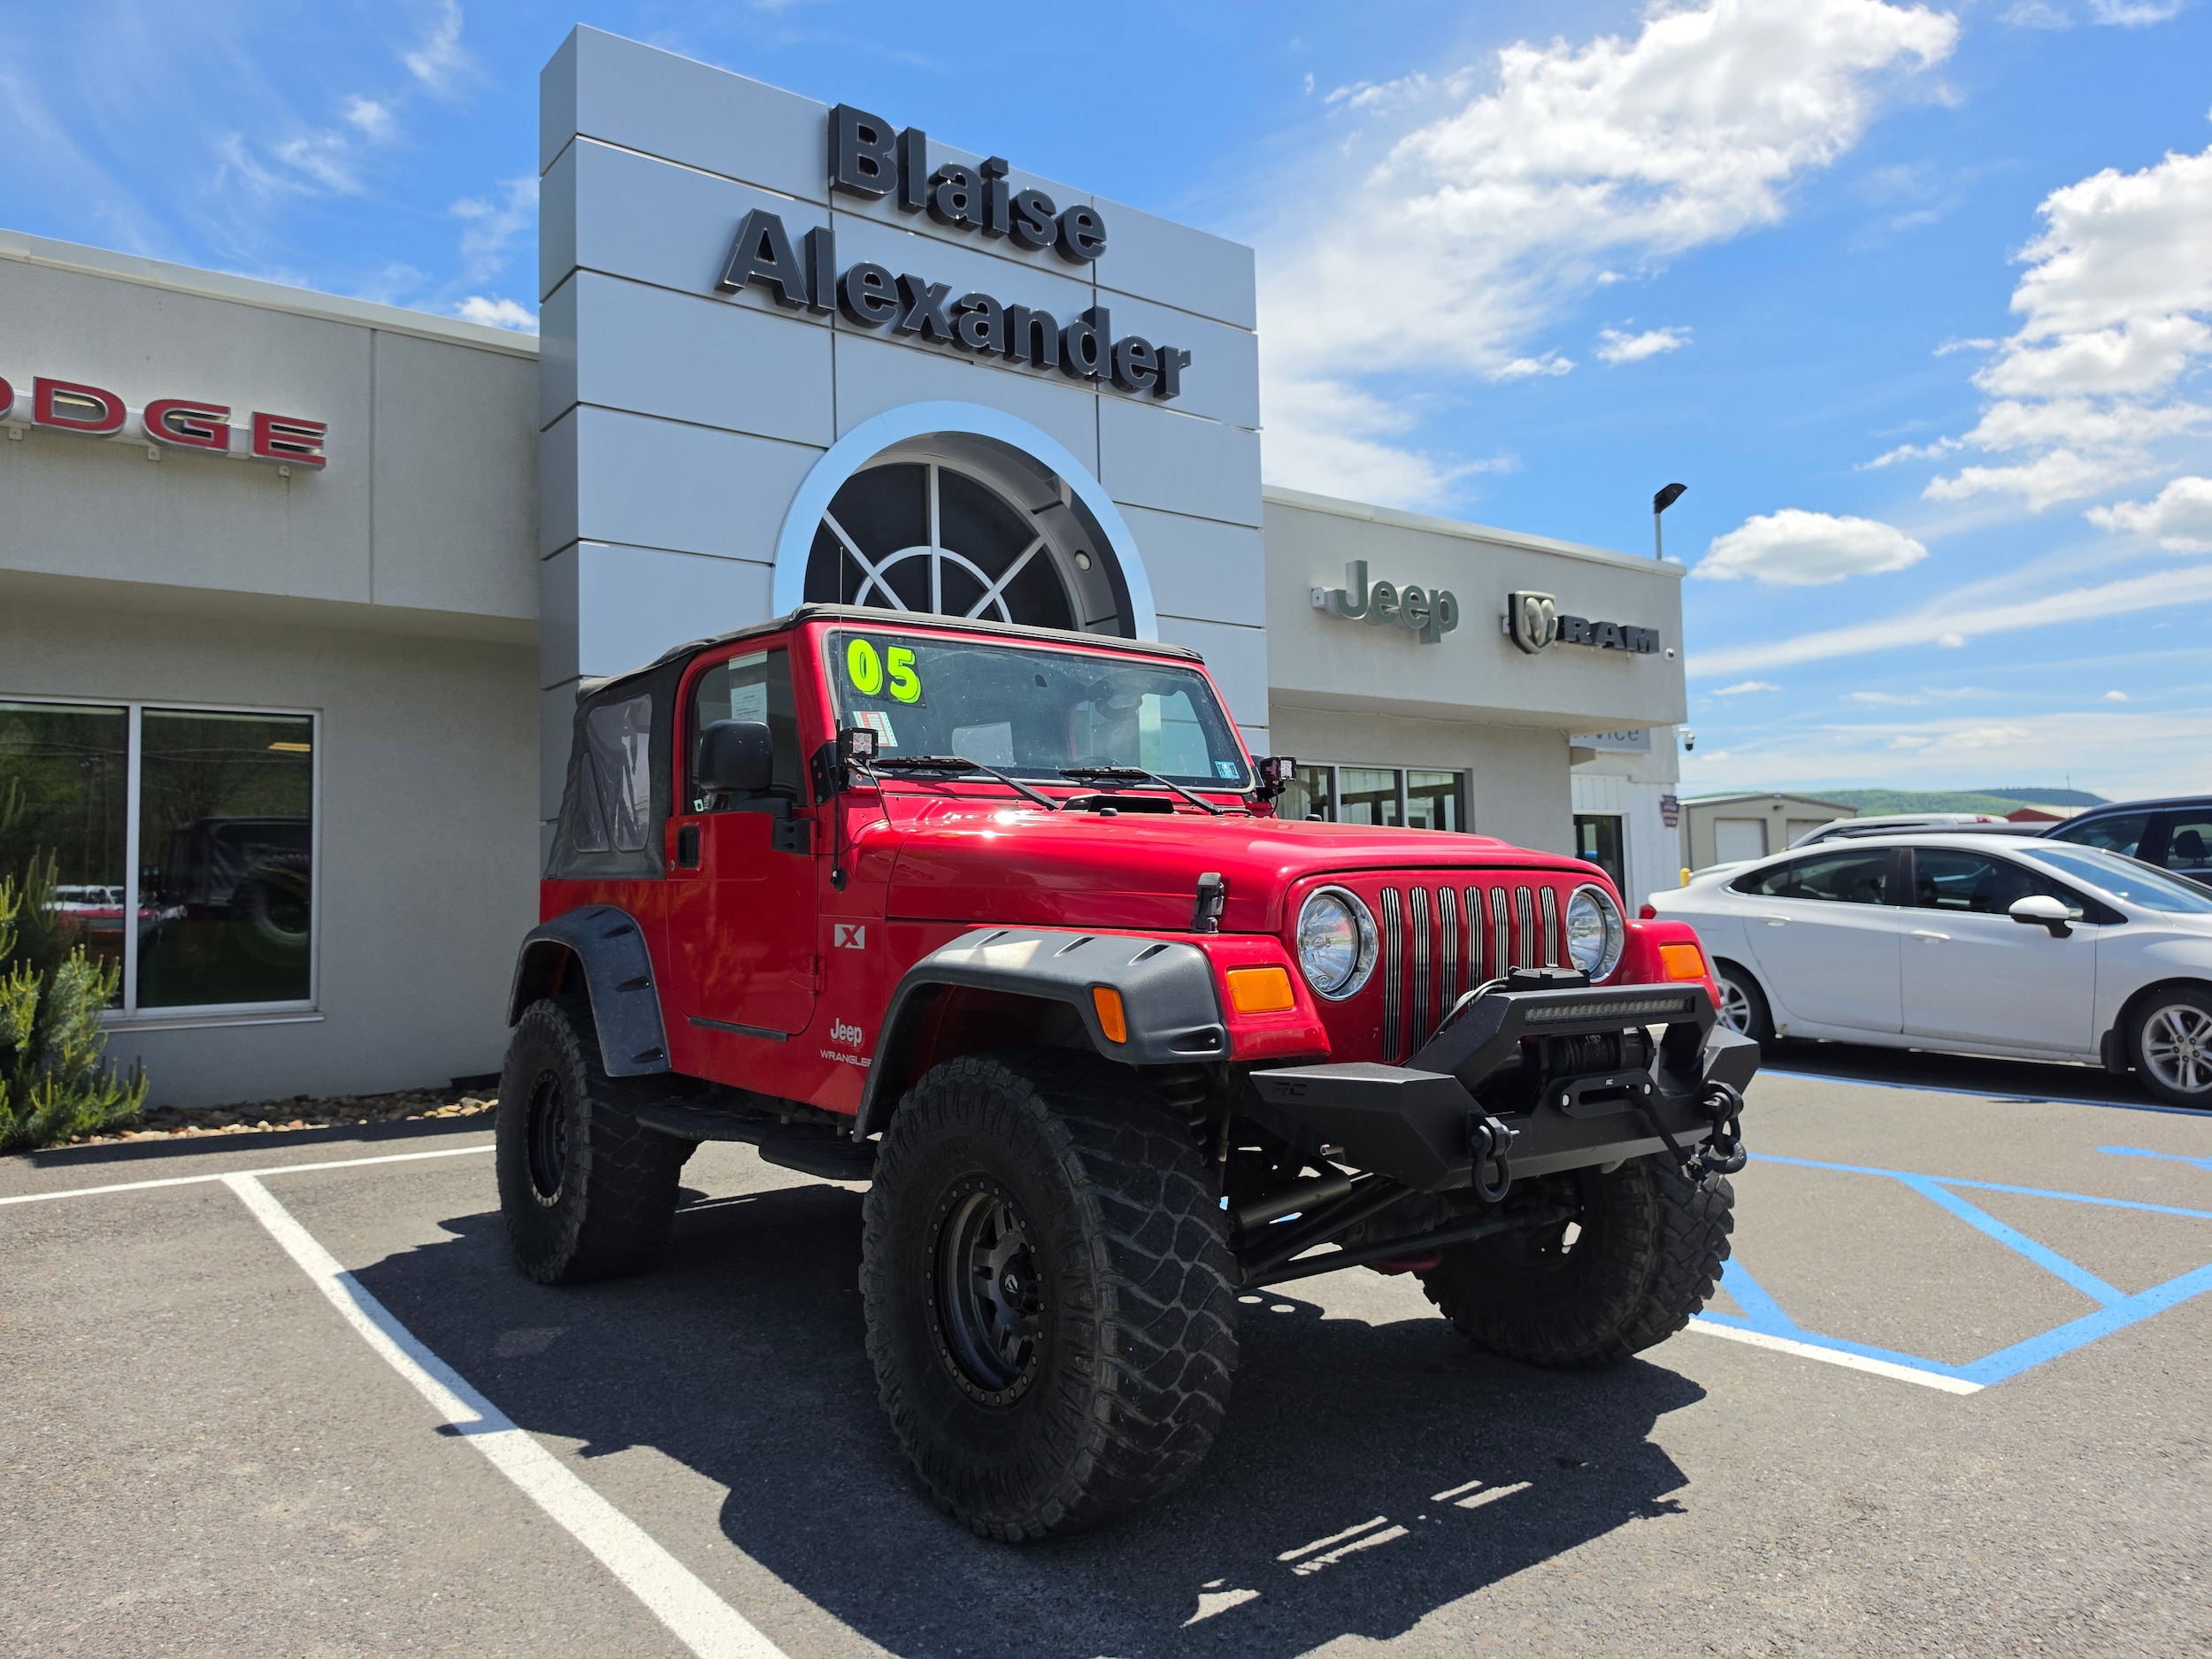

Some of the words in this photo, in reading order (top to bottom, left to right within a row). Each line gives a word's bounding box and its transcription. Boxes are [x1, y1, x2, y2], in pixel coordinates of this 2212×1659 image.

[829, 103, 1108, 265] Blaise
[715, 208, 1191, 400] Alexander
[0, 375, 327, 470] DGE
[1332, 559, 1459, 644] Jeep
[1562, 615, 1660, 654] RAM
[847, 638, 922, 703] 05
[834, 923, 865, 949] X
[830, 1018, 864, 1048] Jeep
